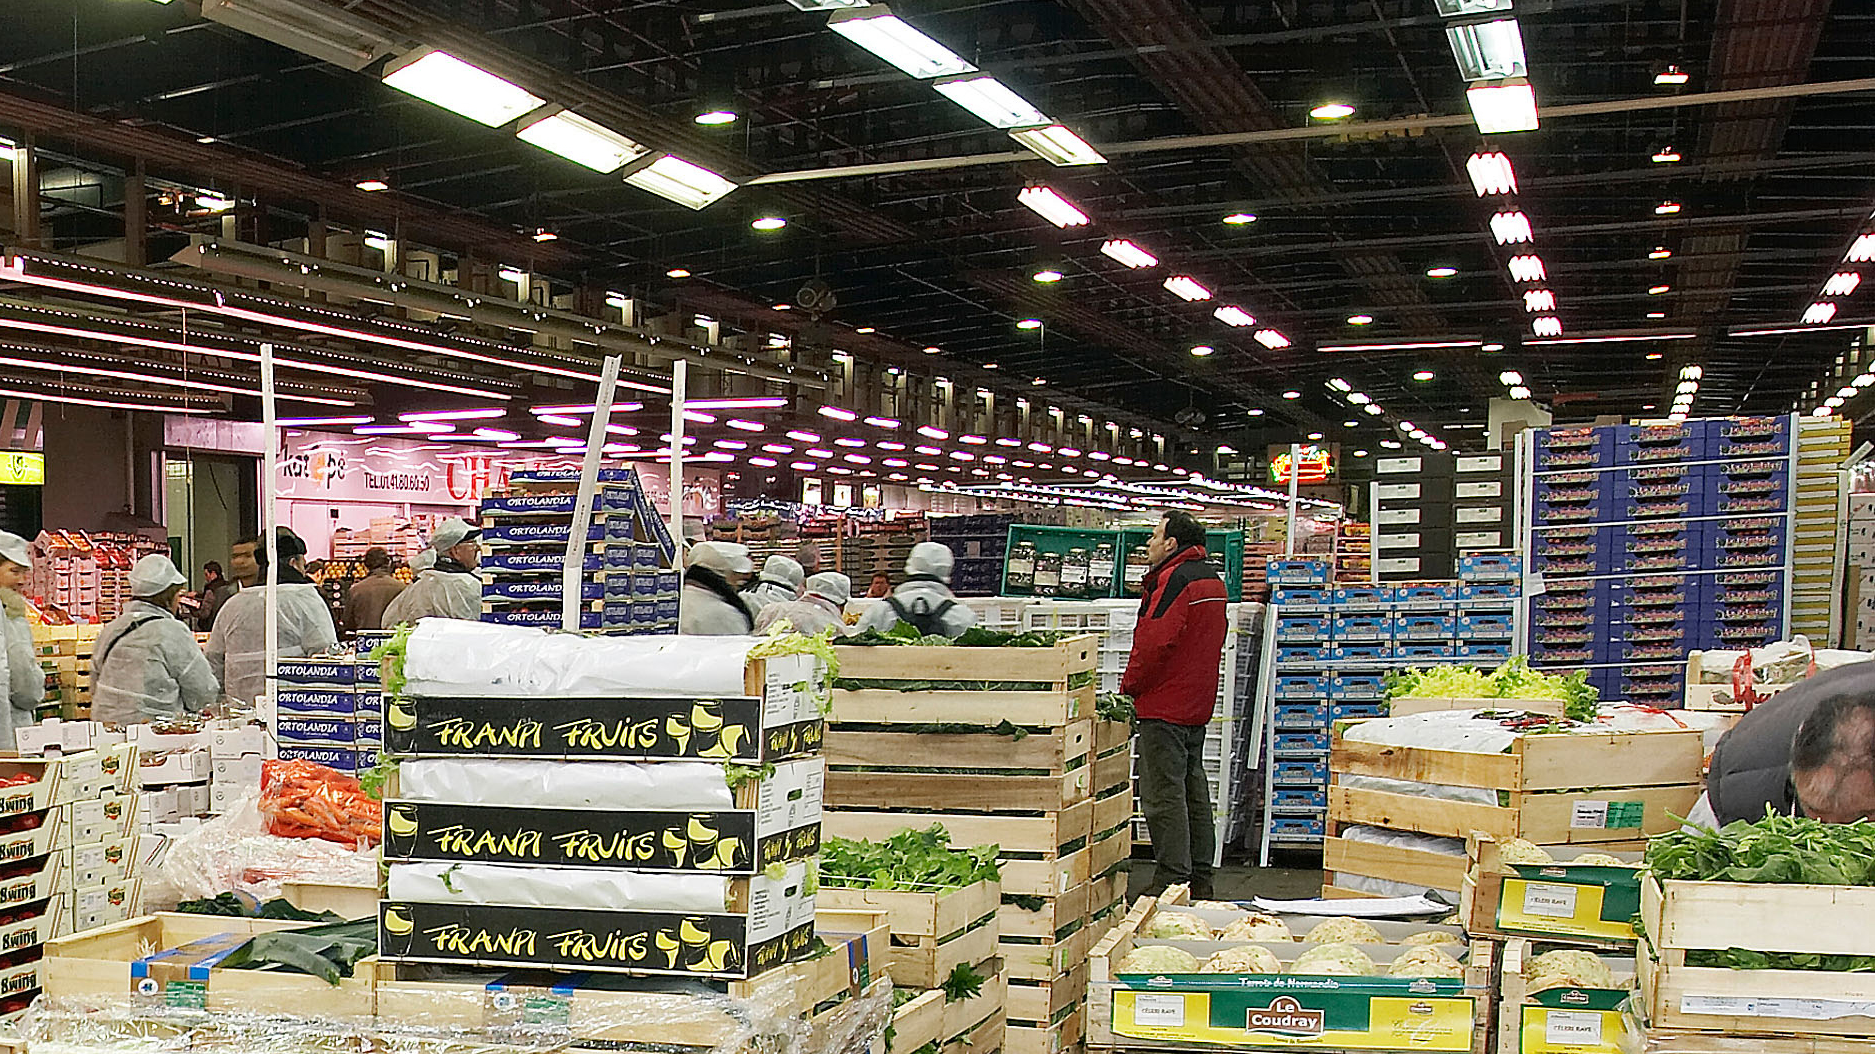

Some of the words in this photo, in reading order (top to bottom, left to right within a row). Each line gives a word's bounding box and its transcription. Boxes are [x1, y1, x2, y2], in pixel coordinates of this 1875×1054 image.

[507, 497, 571, 506] ORTOLANDIA
[278, 665, 338, 677] ORTOLANDIA
[278, 693, 338, 705] ORTOLANDIA
[278, 722, 338, 733] ORTOLANDIA
[427, 717, 543, 749] FRANPI
[279, 750, 340, 761] ORTOLANDIA
[427, 825, 542, 857] FRANPI
[0, 881, 36, 903] Swing
[2, 929, 37, 950] Swing
[423, 924, 537, 956] FRANPI
[1, 973, 37, 995] Swing
[1276, 1002, 1295, 1013] Le
[1251, 1014, 1319, 1030] Coudray
